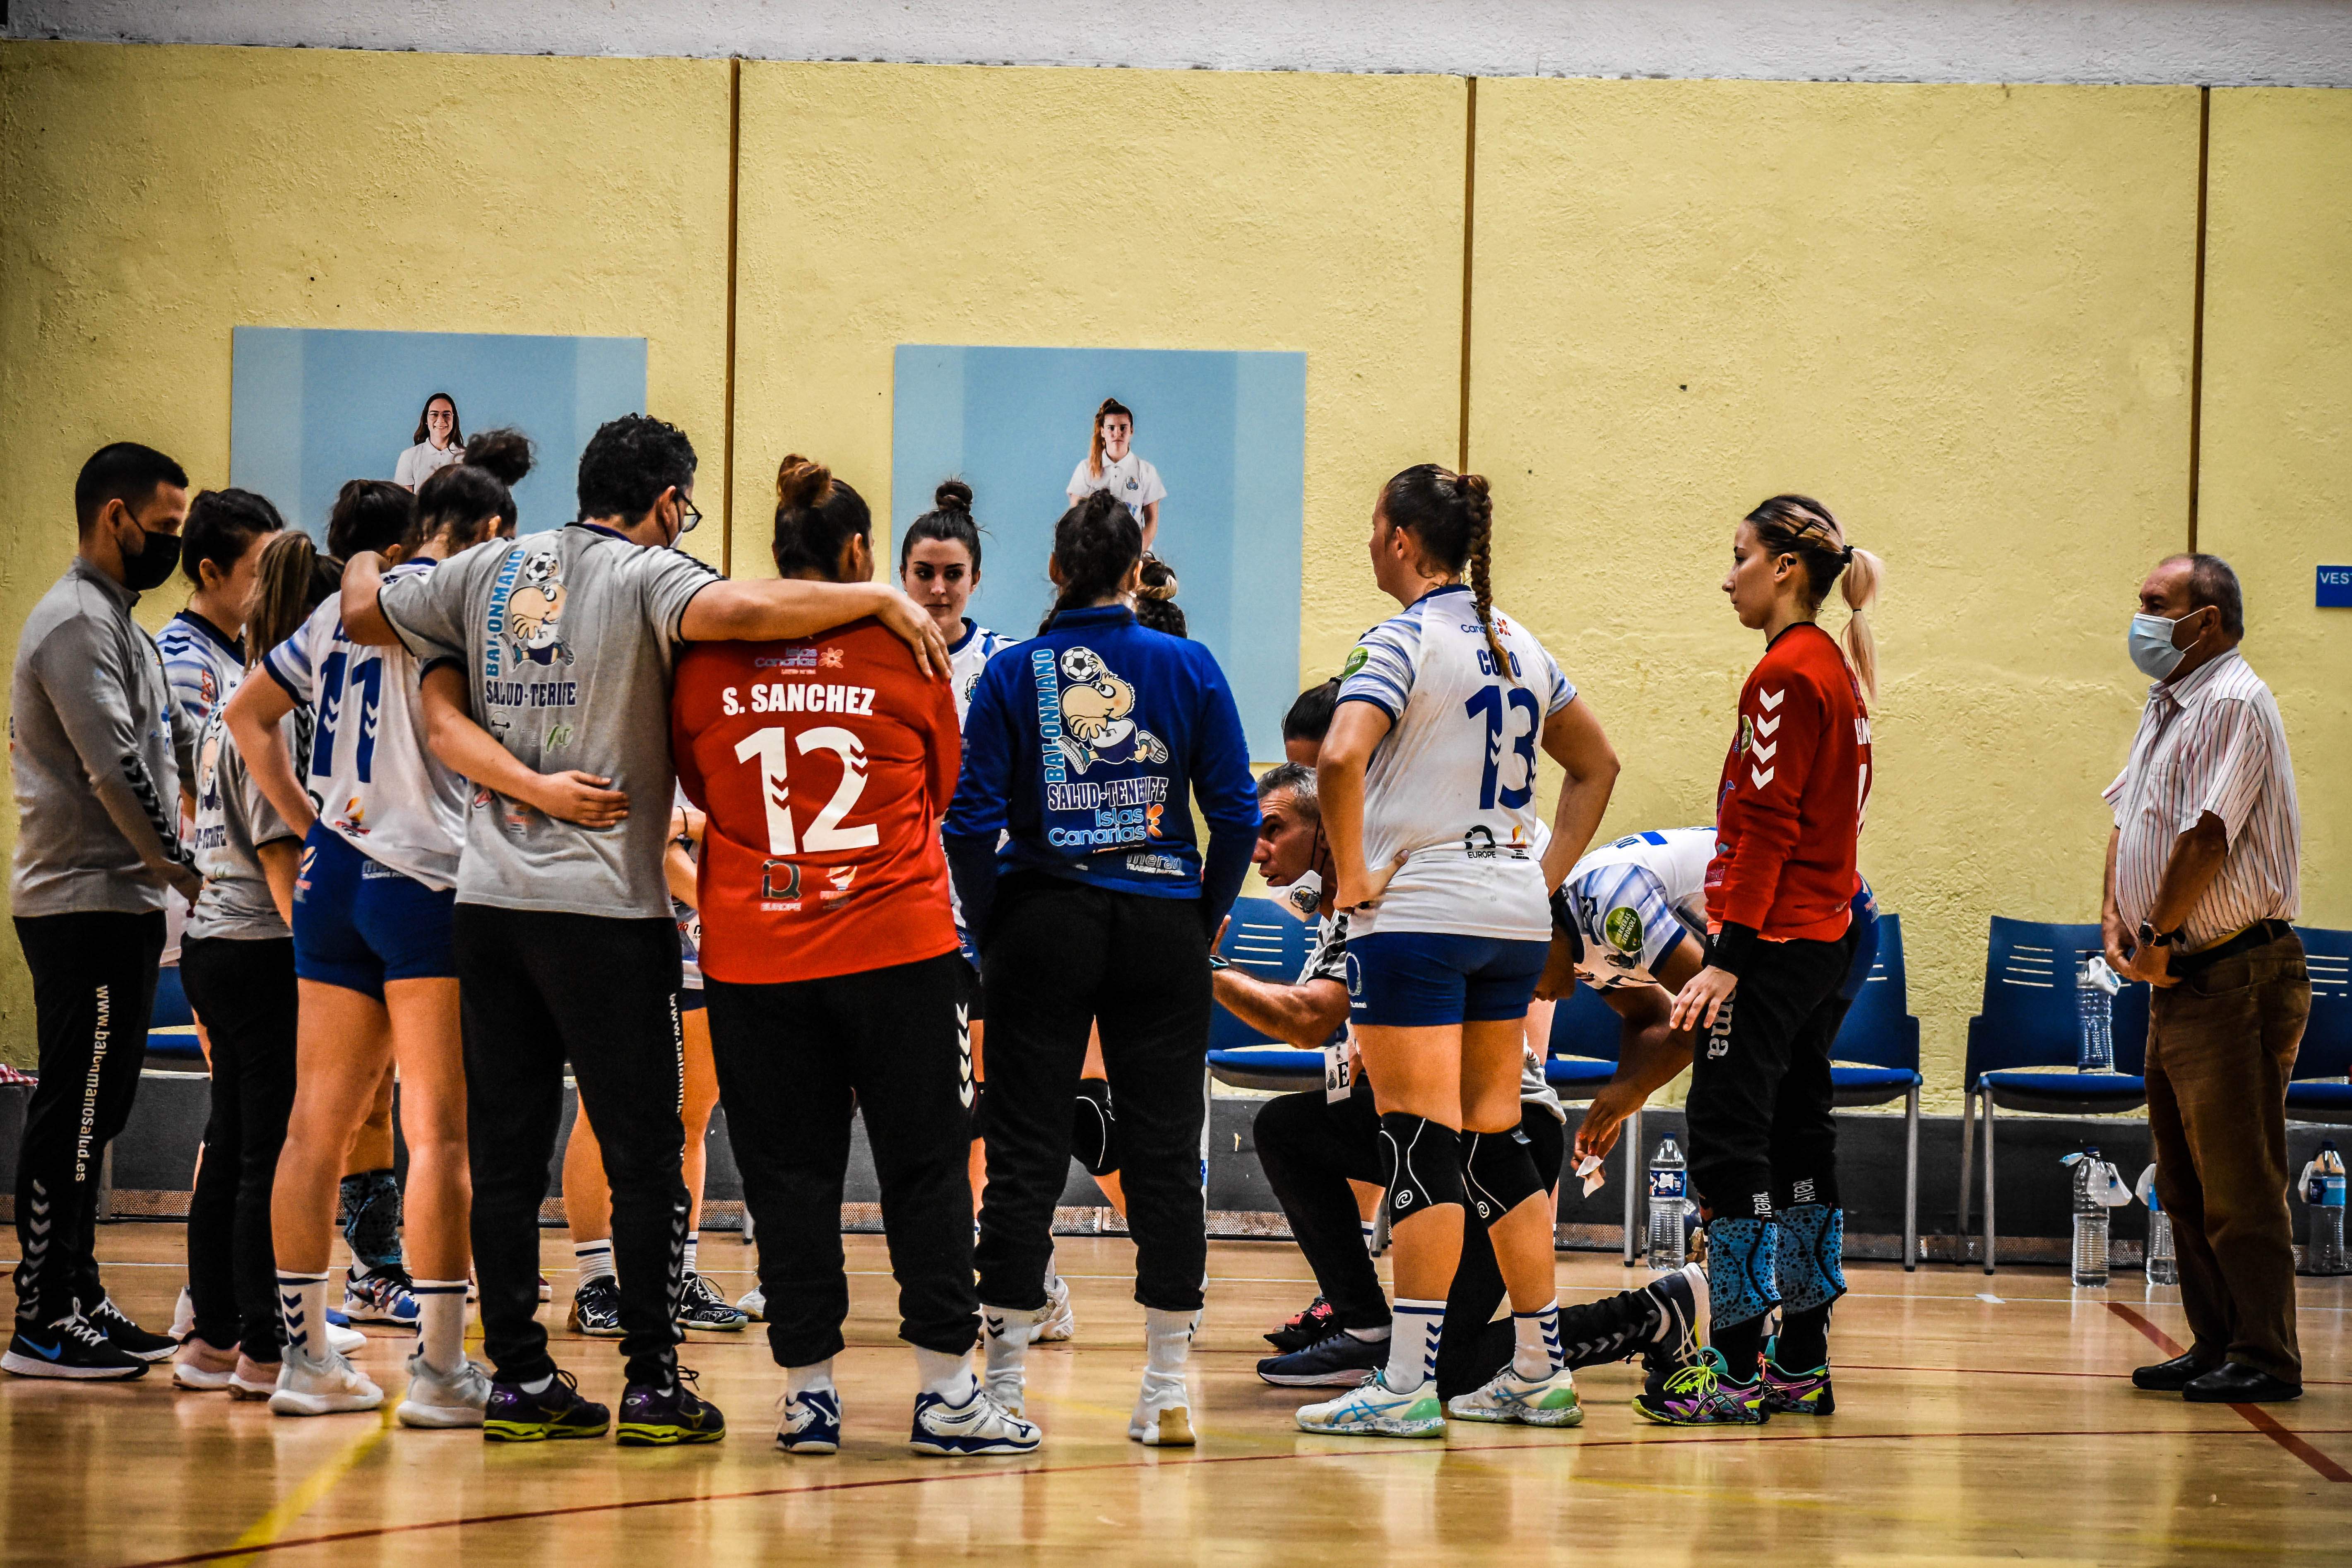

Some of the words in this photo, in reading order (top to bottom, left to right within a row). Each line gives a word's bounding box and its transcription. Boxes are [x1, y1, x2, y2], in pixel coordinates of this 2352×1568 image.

[312, 651, 382, 784] 11
[722, 686, 745, 716] S.
[751, 683, 876, 716] SANCHEZ
[1465, 685, 1540, 810] 13
[734, 726, 879, 856] 12
[1048, 824, 1147, 847] Canarias
[1095, 807, 1144, 827] Islas
[75, 984, 111, 1182] www.balonmanosalud.es
